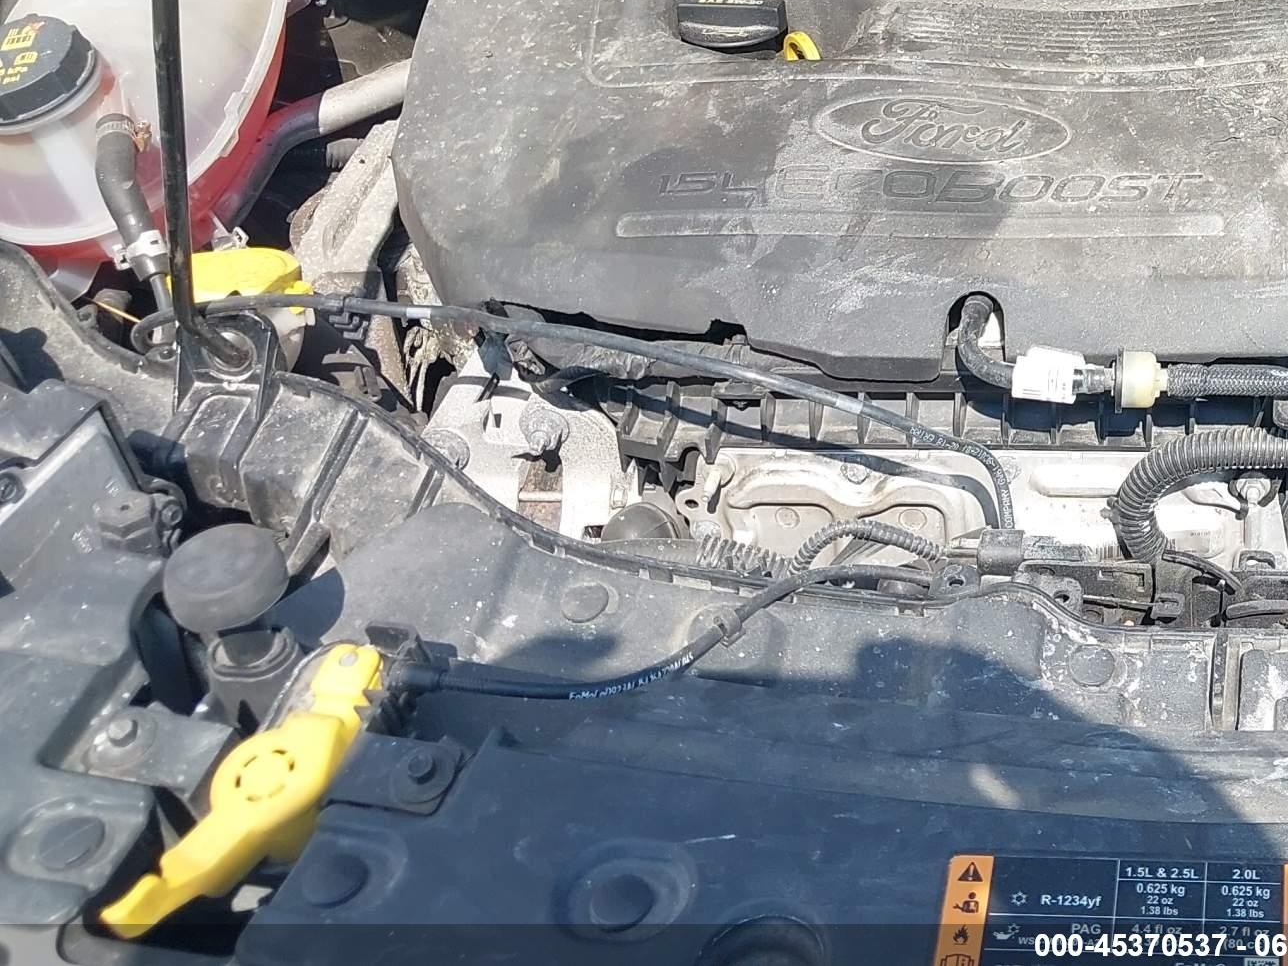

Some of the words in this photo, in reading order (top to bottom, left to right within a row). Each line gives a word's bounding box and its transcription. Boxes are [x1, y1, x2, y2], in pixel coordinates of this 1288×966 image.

[860, 97, 1029, 154] Ford
[774, 163, 1204, 204] ECOBOOST
[1125, 867, 1154, 879] 1.5L
[1156, 868, 1168, 879] &
[1170, 868, 1200, 880] 2.5L
[1232, 869, 1261, 880] 2.0L
[1136, 883, 1168, 894] 0.625
[1171, 883, 1186, 897] kg
[1221, 885, 1254, 896] 0.625
[1256, 886, 1271, 900] kg
[1040, 895, 1102, 910] R-1234yf
[1146, 895, 1159, 905] 22
[1161, 897, 1174, 905] oz
[1232, 898, 1245, 907] 22
[1246, 900, 1259, 908] oz
[1141, 906, 1161, 916] 1.38
[1163, 907, 1179, 916] lbs
[1226, 908, 1247, 918] 1.38
[1248, 909, 1265, 918] lbs
[1071, 923, 1101, 935] PAG
[1132, 924, 1151, 934] 4.4
[1154, 924, 1164, 934] fl
[1167, 926, 1183, 935] oz
[1220, 925, 1239, 936] 2.7
[1242, 926, 1251, 936] fl
